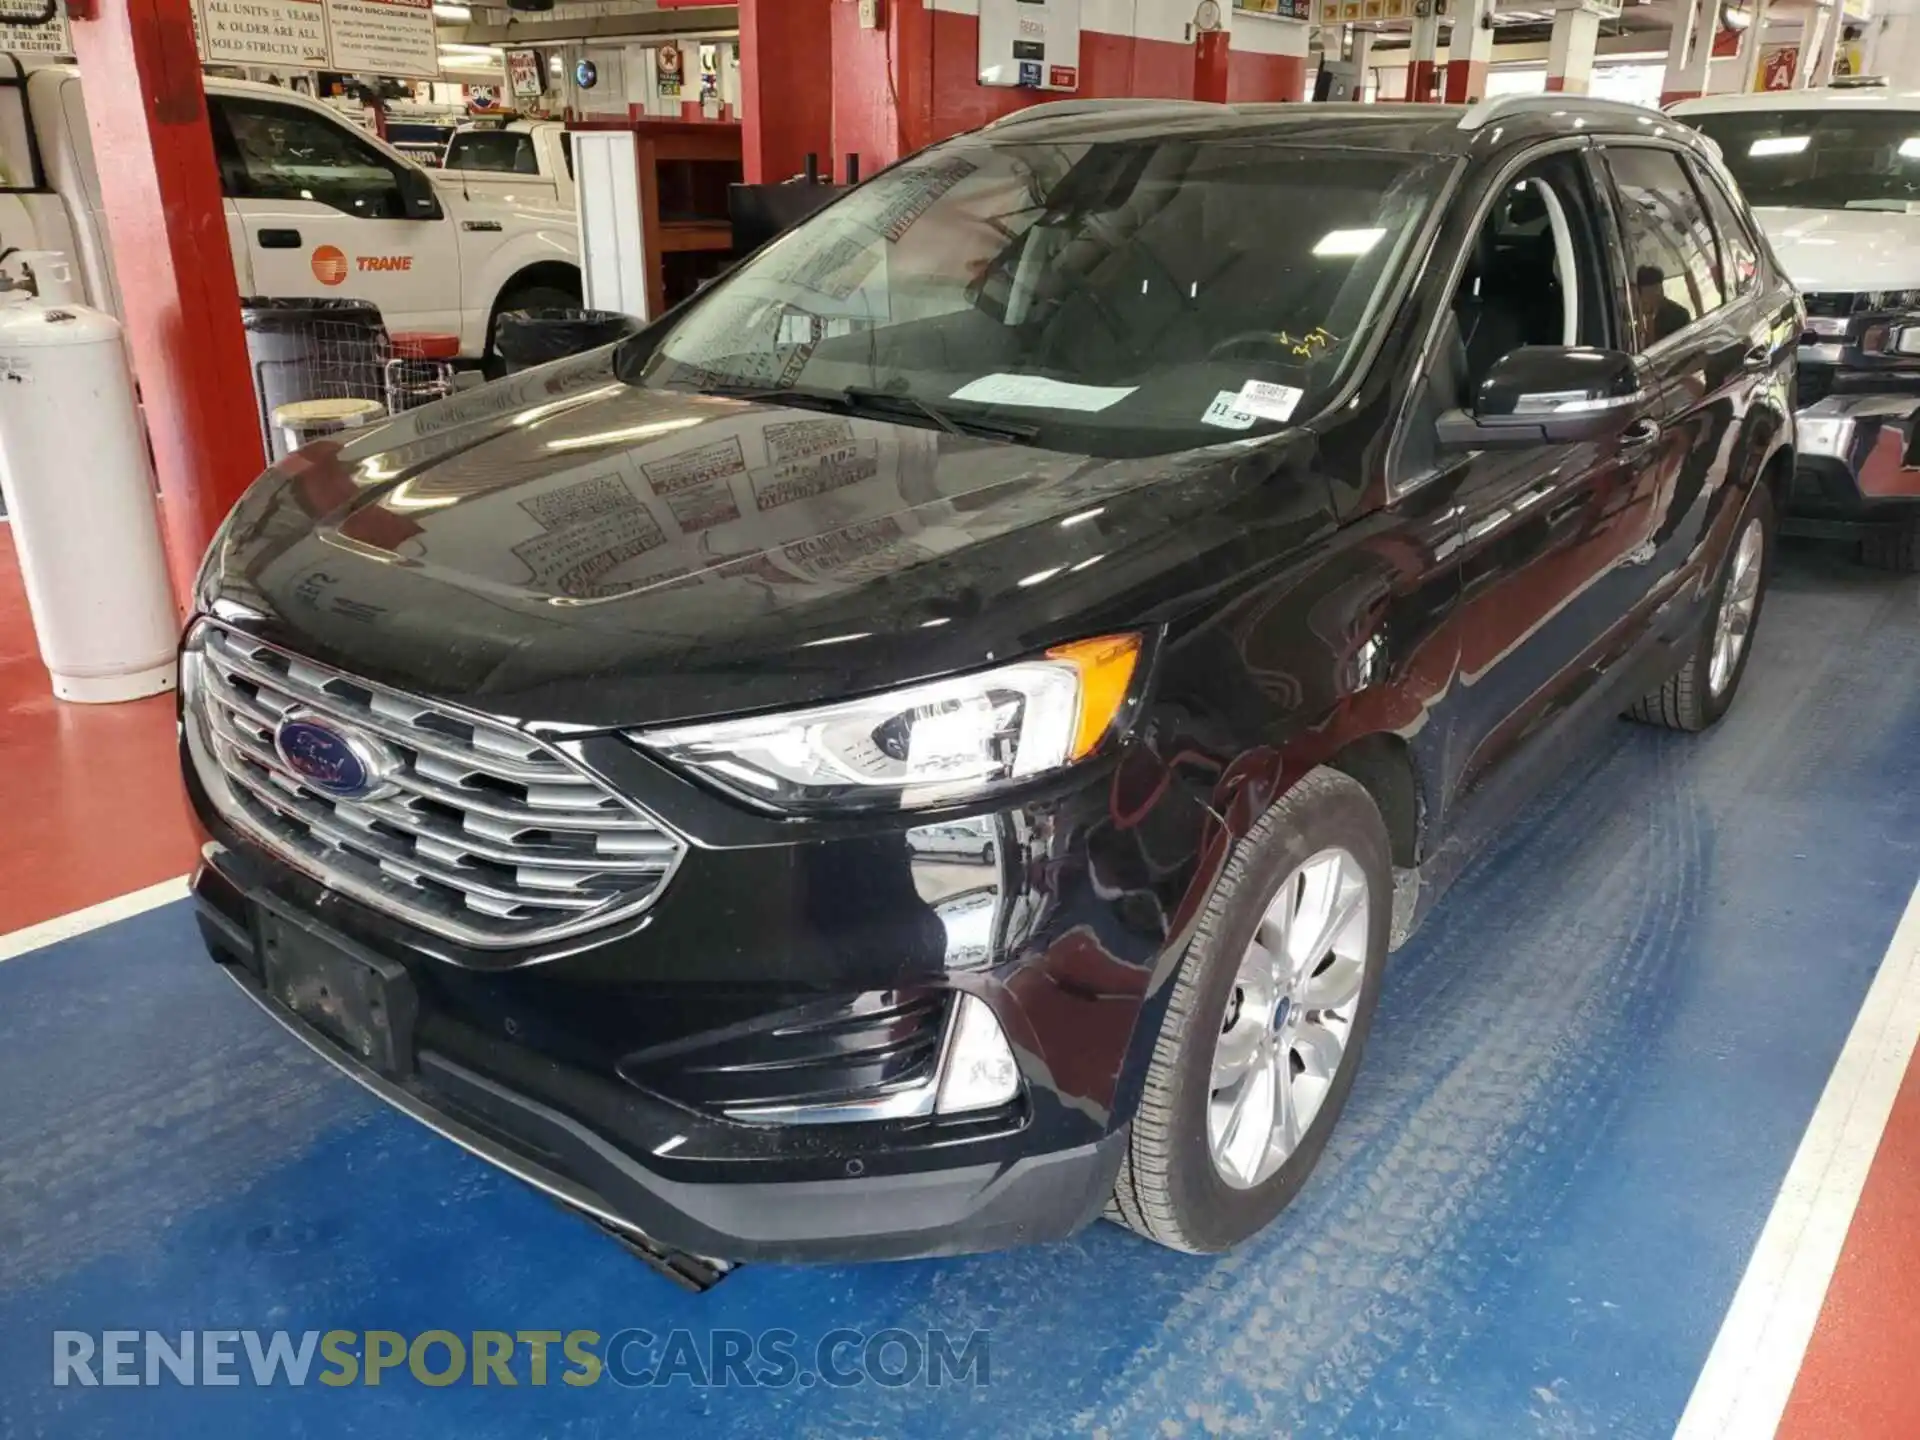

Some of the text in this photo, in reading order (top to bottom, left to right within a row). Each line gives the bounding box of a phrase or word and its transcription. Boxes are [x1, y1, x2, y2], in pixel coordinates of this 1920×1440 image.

[209, 2, 231, 13] ALL
[233, 4, 270, 17] UNITS
[286, 9, 320, 21] YEARS
[217, 21, 318, 39] & OLDER ARE ALL
[211, 39, 242, 50] SOLD
[246, 40, 298, 55] STRICTLY
[302, 46, 314, 57] AS
[356, 256, 412, 272] TRANE
[1212, 402, 1229, 415] 11
